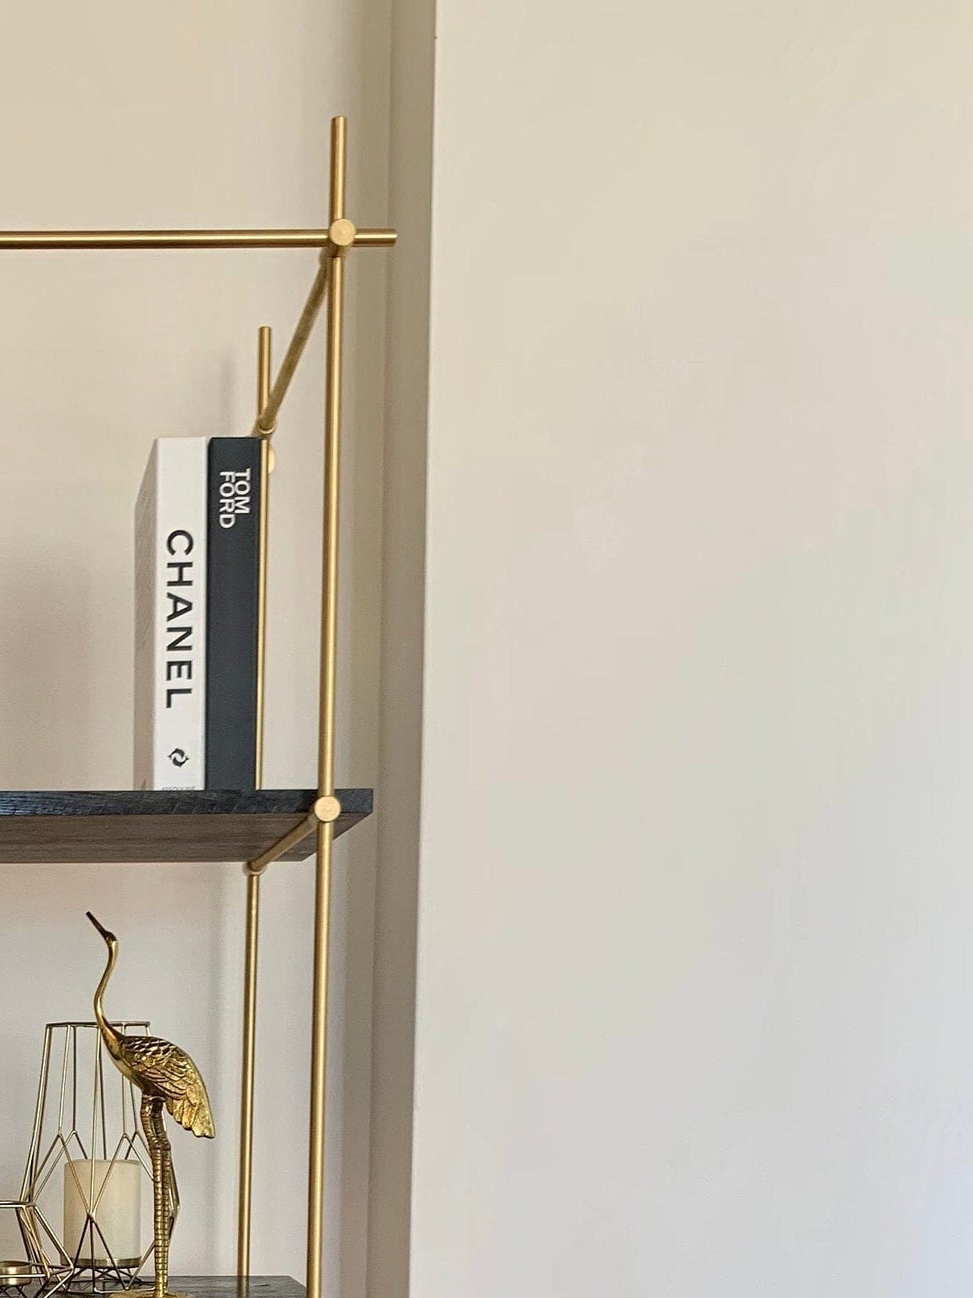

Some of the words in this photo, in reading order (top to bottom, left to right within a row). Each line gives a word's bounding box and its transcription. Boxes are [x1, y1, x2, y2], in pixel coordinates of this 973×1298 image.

[219, 471, 236, 529] FORD
[234, 468, 251, 514] TOM
[166, 529, 194, 709] CHANEL
